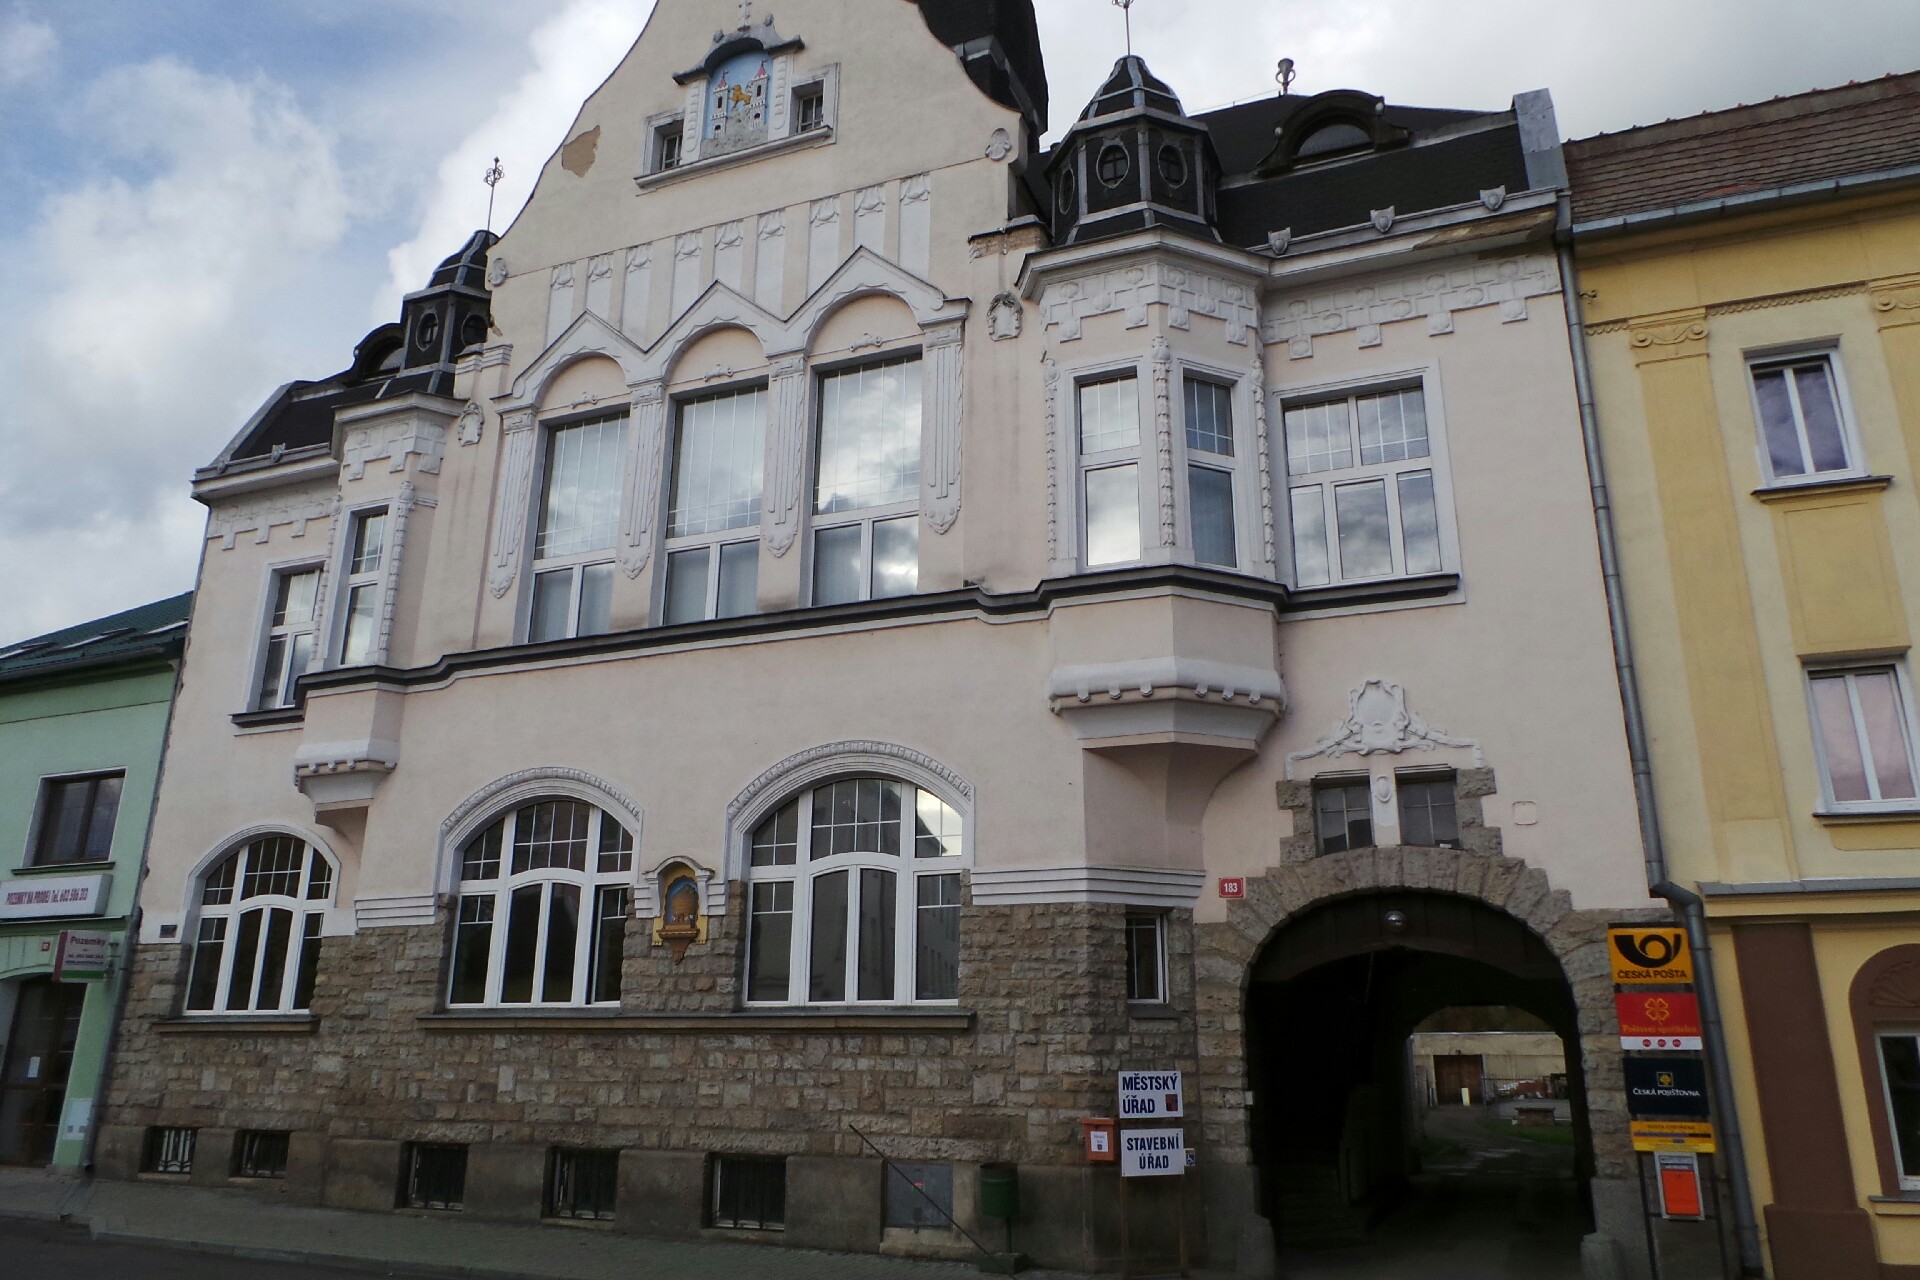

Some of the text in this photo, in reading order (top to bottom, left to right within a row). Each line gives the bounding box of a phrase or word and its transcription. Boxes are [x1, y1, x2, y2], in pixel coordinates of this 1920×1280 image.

[1223, 882, 1238, 893] 183
[70, 936, 107, 947] Pozemky
[1617, 968, 1687, 979] ČESKÁ POŠTA
[1122, 1073, 1178, 1091] MĚSTSKÝ
[1632, 1087, 1700, 1097] ČESKÁ POJIŠŤOVNA
[1122, 1094, 1155, 1113] ÚŘAD
[1126, 1133, 1180, 1151] STAVEBNÍ
[1139, 1153, 1169, 1170] ÚŘAD
